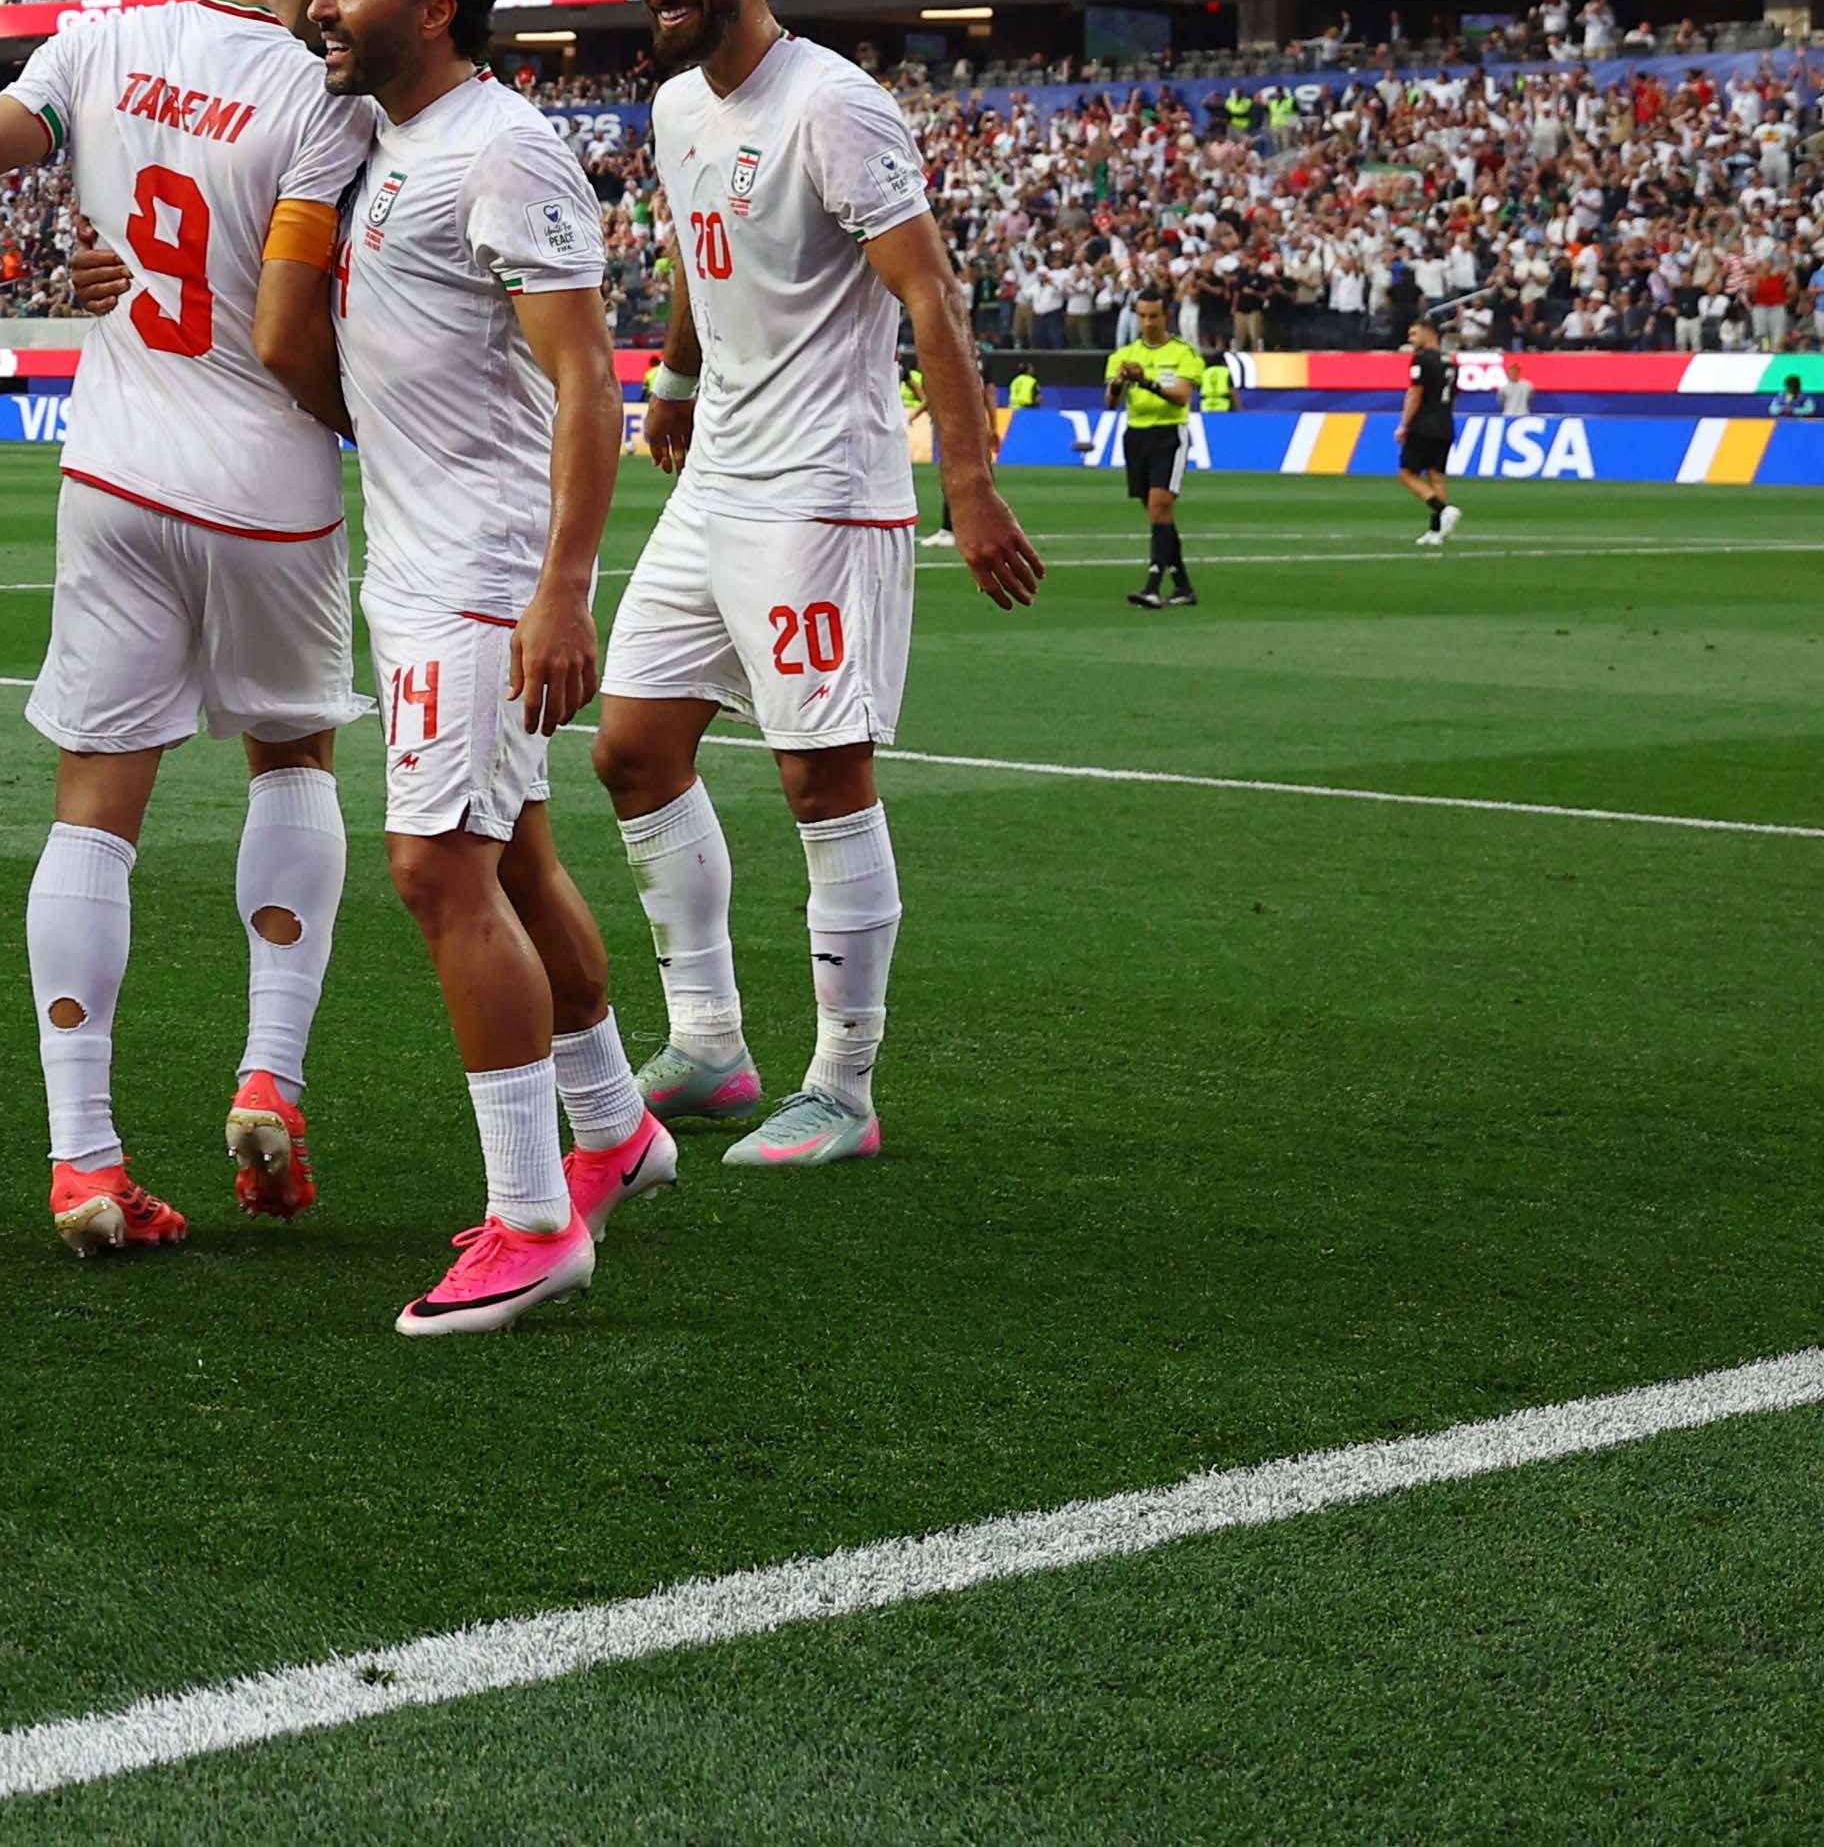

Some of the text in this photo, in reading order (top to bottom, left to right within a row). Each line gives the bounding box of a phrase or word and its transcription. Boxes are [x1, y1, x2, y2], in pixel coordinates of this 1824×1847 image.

[115, 72, 258, 145] TAREMI
[546, 113, 621, 141] 026
[125, 163, 214, 359] 9
[689, 211, 733, 280] 20
[1456, 363, 1509, 391] OA
[11, 396, 73, 442] VIS
[769, 601, 844, 675] 20
[386, 659, 441, 746] 14
